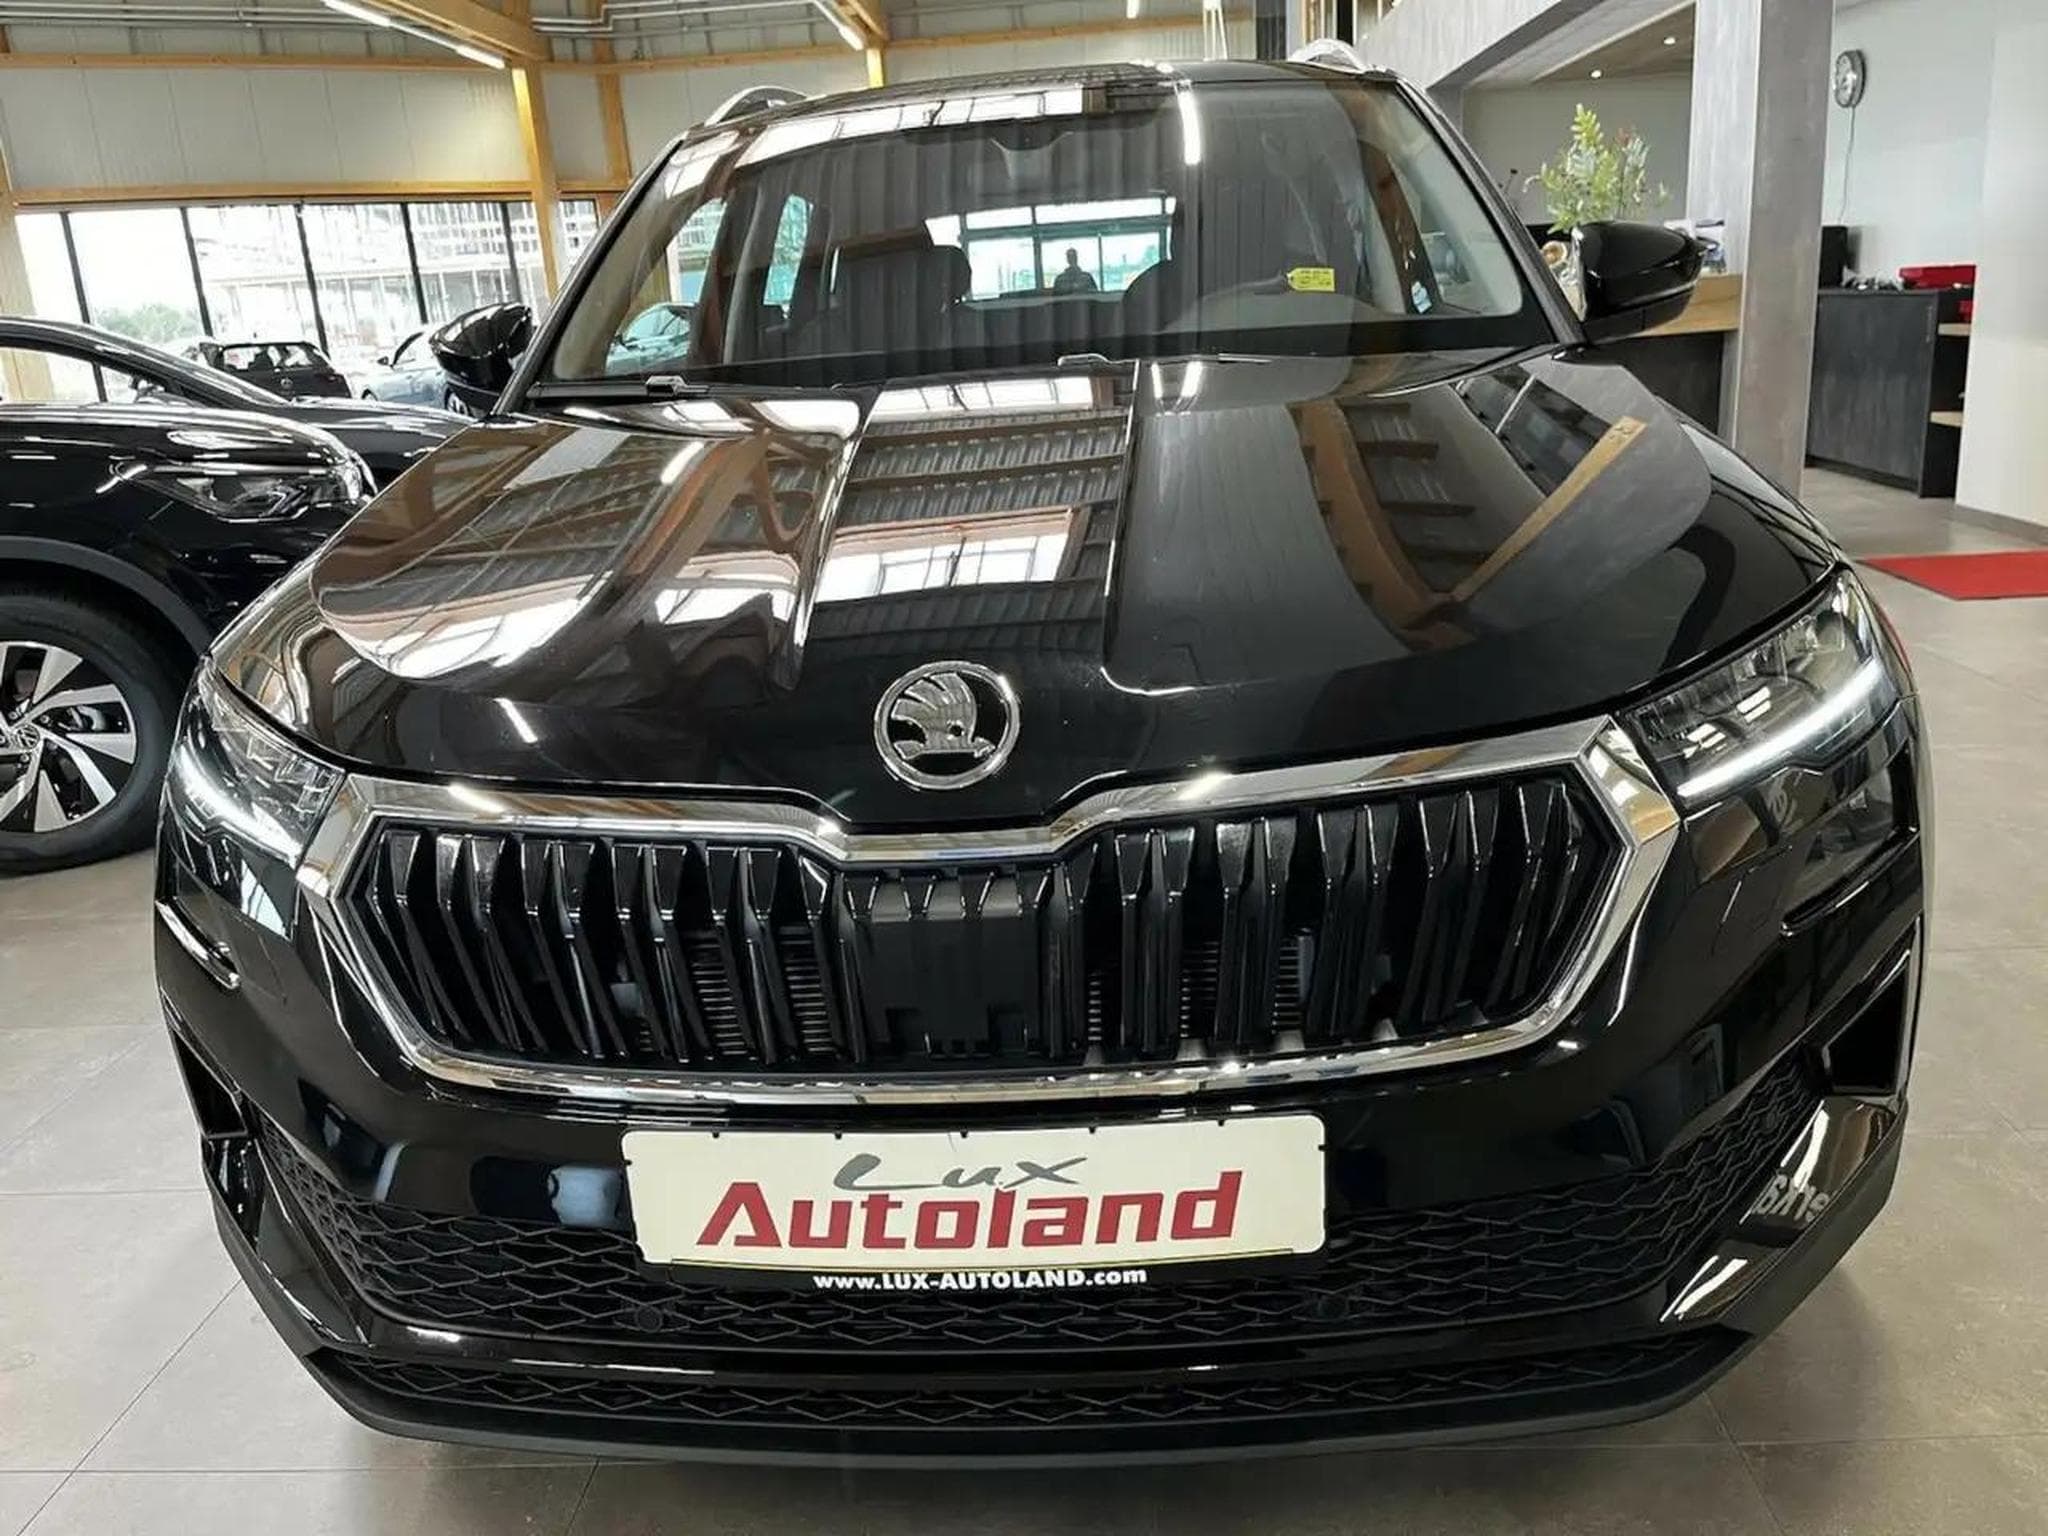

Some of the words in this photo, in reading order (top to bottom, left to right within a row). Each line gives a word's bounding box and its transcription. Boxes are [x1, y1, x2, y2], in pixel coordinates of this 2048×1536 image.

[834, 1153, 1087, 1191] Lux
[696, 1170, 1243, 1249] Autoland
[813, 1268, 1147, 1291] www.LUX-AUTOLAND.com
